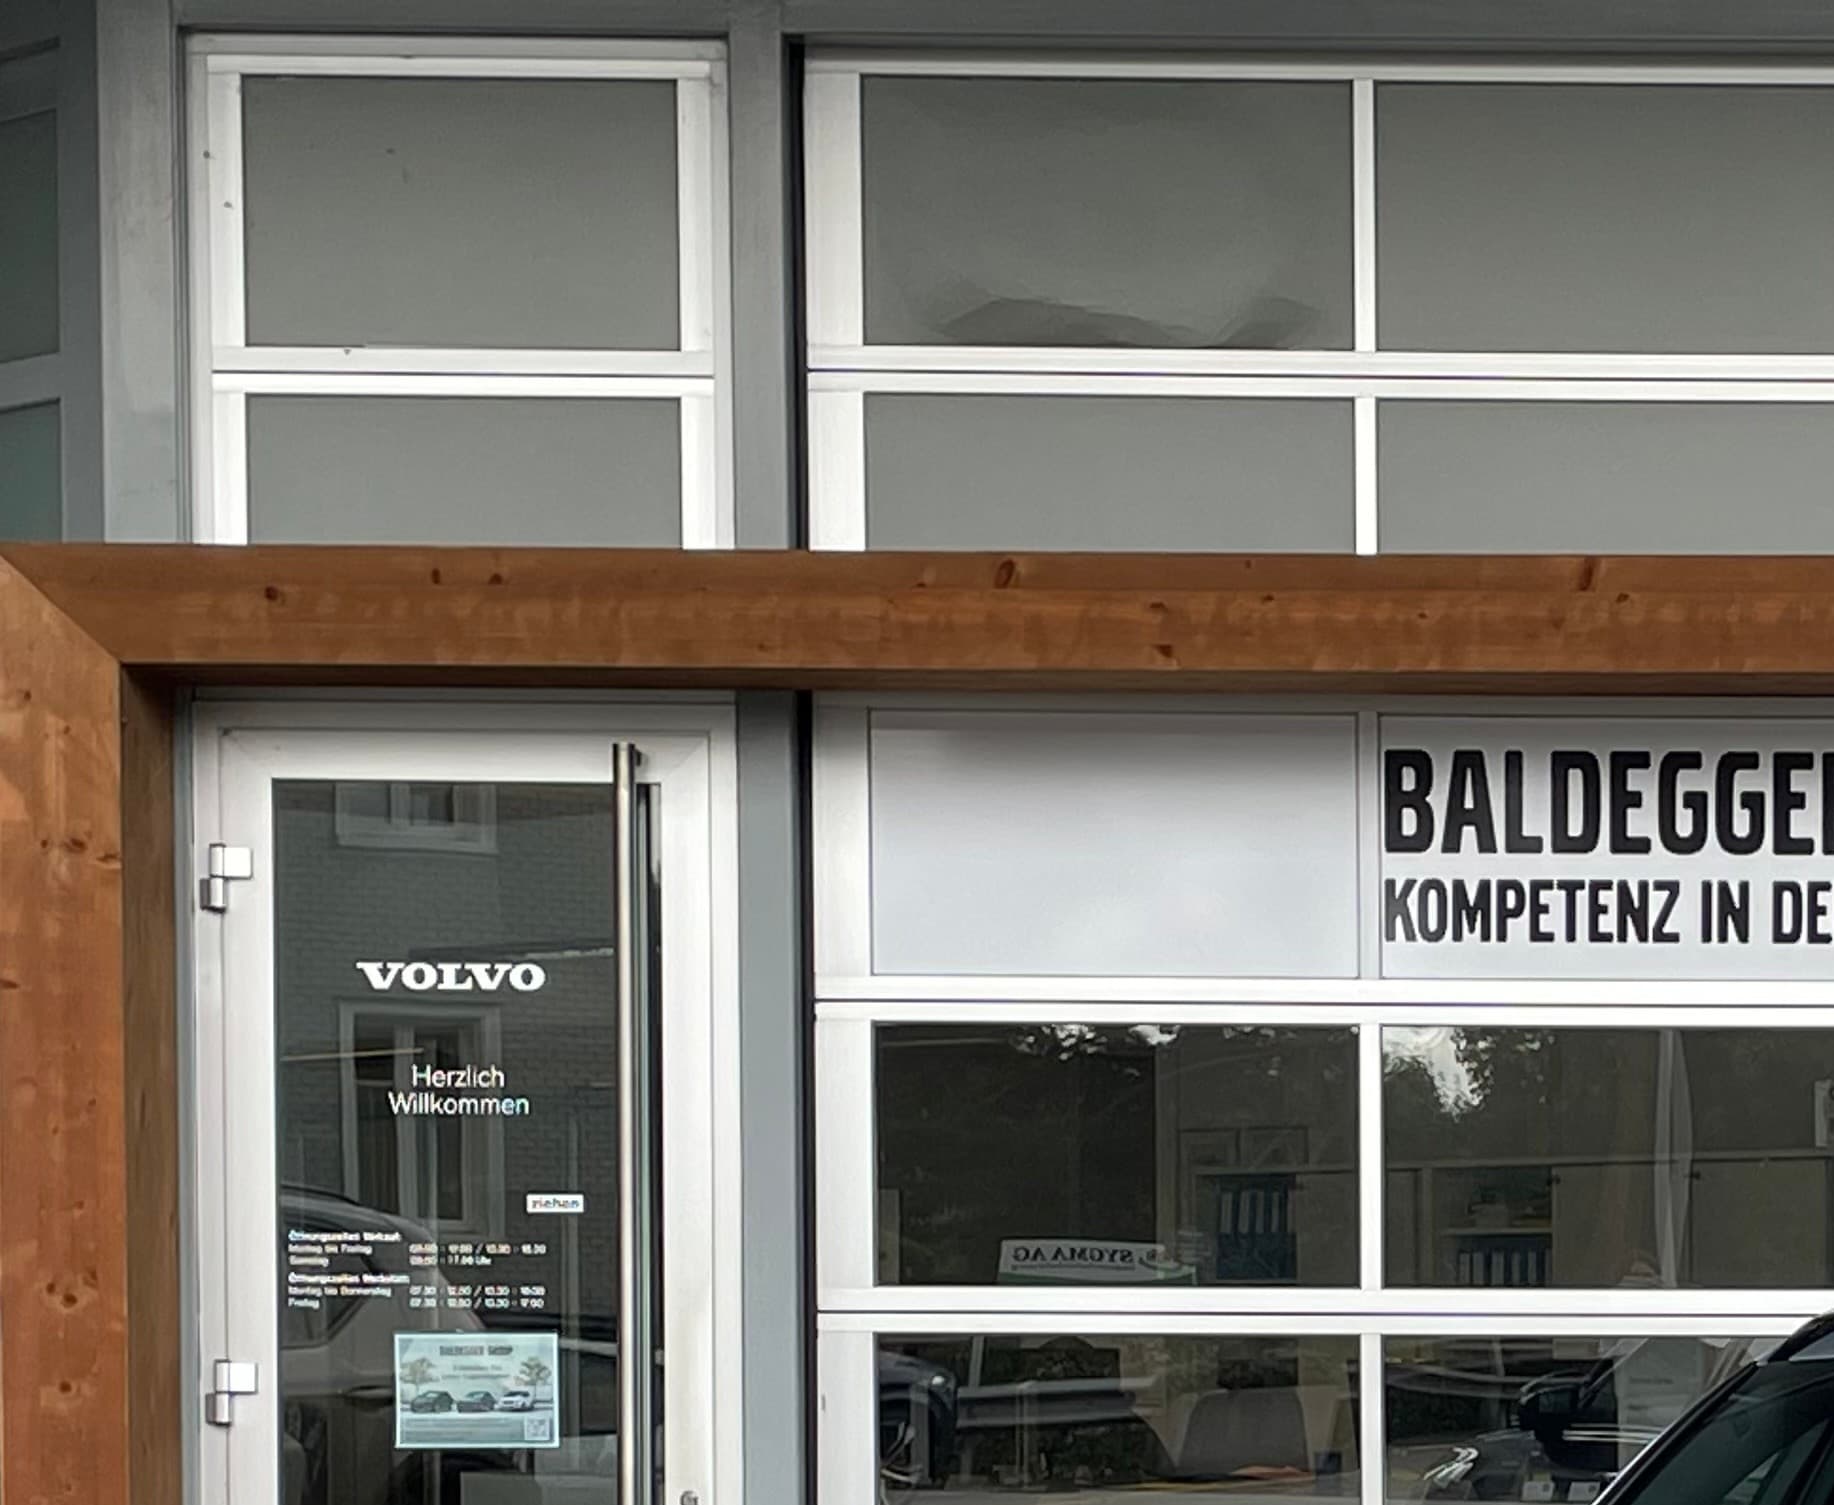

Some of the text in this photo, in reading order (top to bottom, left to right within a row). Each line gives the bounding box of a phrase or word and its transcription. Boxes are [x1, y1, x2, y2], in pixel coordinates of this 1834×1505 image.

[1384, 878, 1680, 945] KOMPETENZ
[1701, 879, 1750, 945] IN
[356, 962, 546, 991] VOLVO
[412, 1064, 505, 1088] Herzlich
[388, 1091, 530, 1115] Willkommen
